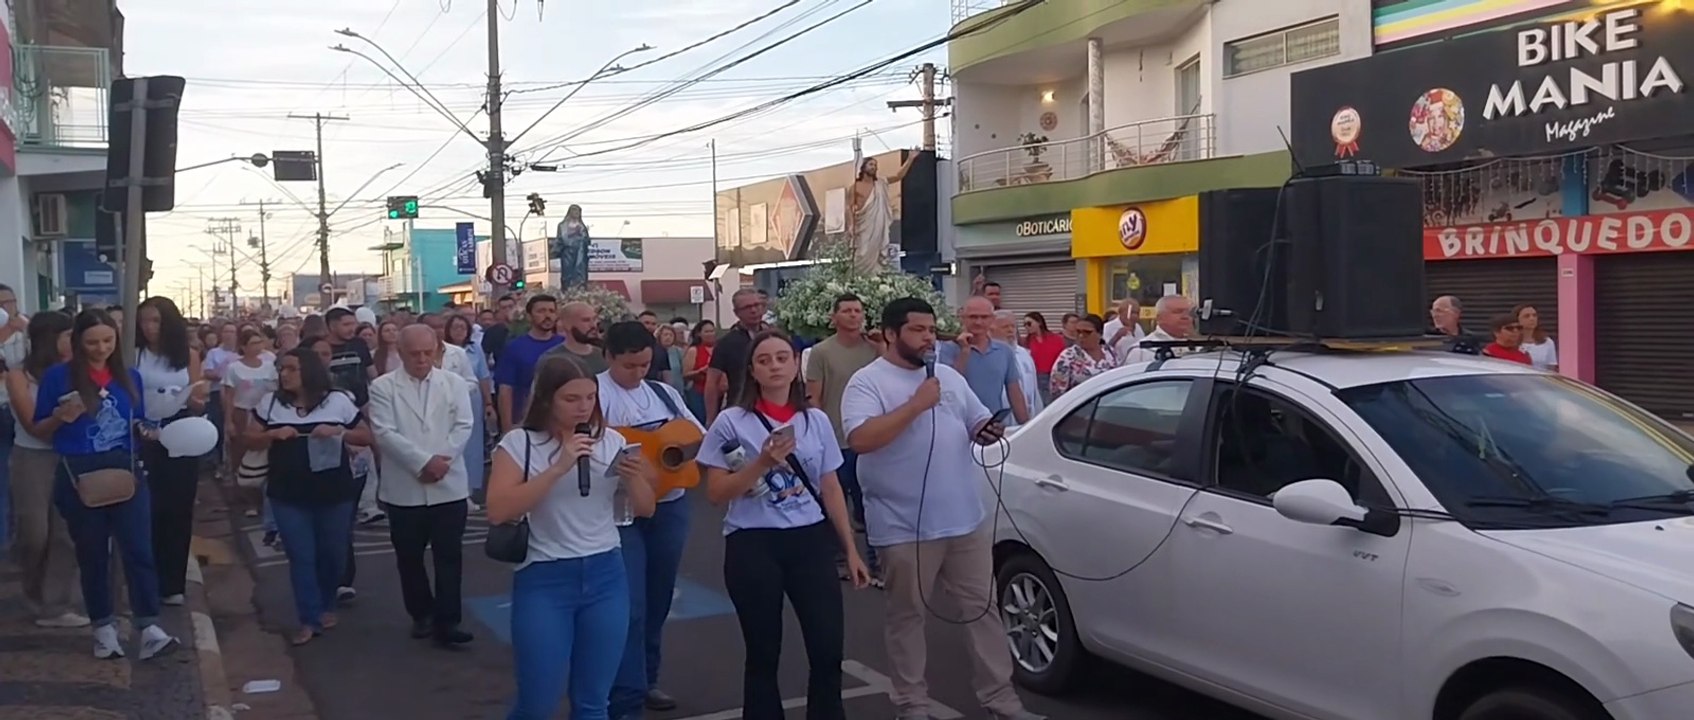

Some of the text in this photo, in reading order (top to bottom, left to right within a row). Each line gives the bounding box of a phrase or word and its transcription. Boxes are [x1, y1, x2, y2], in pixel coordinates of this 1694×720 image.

[1518, 9, 1638, 67] BIKE
[1482, 55, 1684, 120] MANIA
[1545, 106, 1616, 142] Magazine
[1437, 212, 1692, 257] BRINQUEDO
